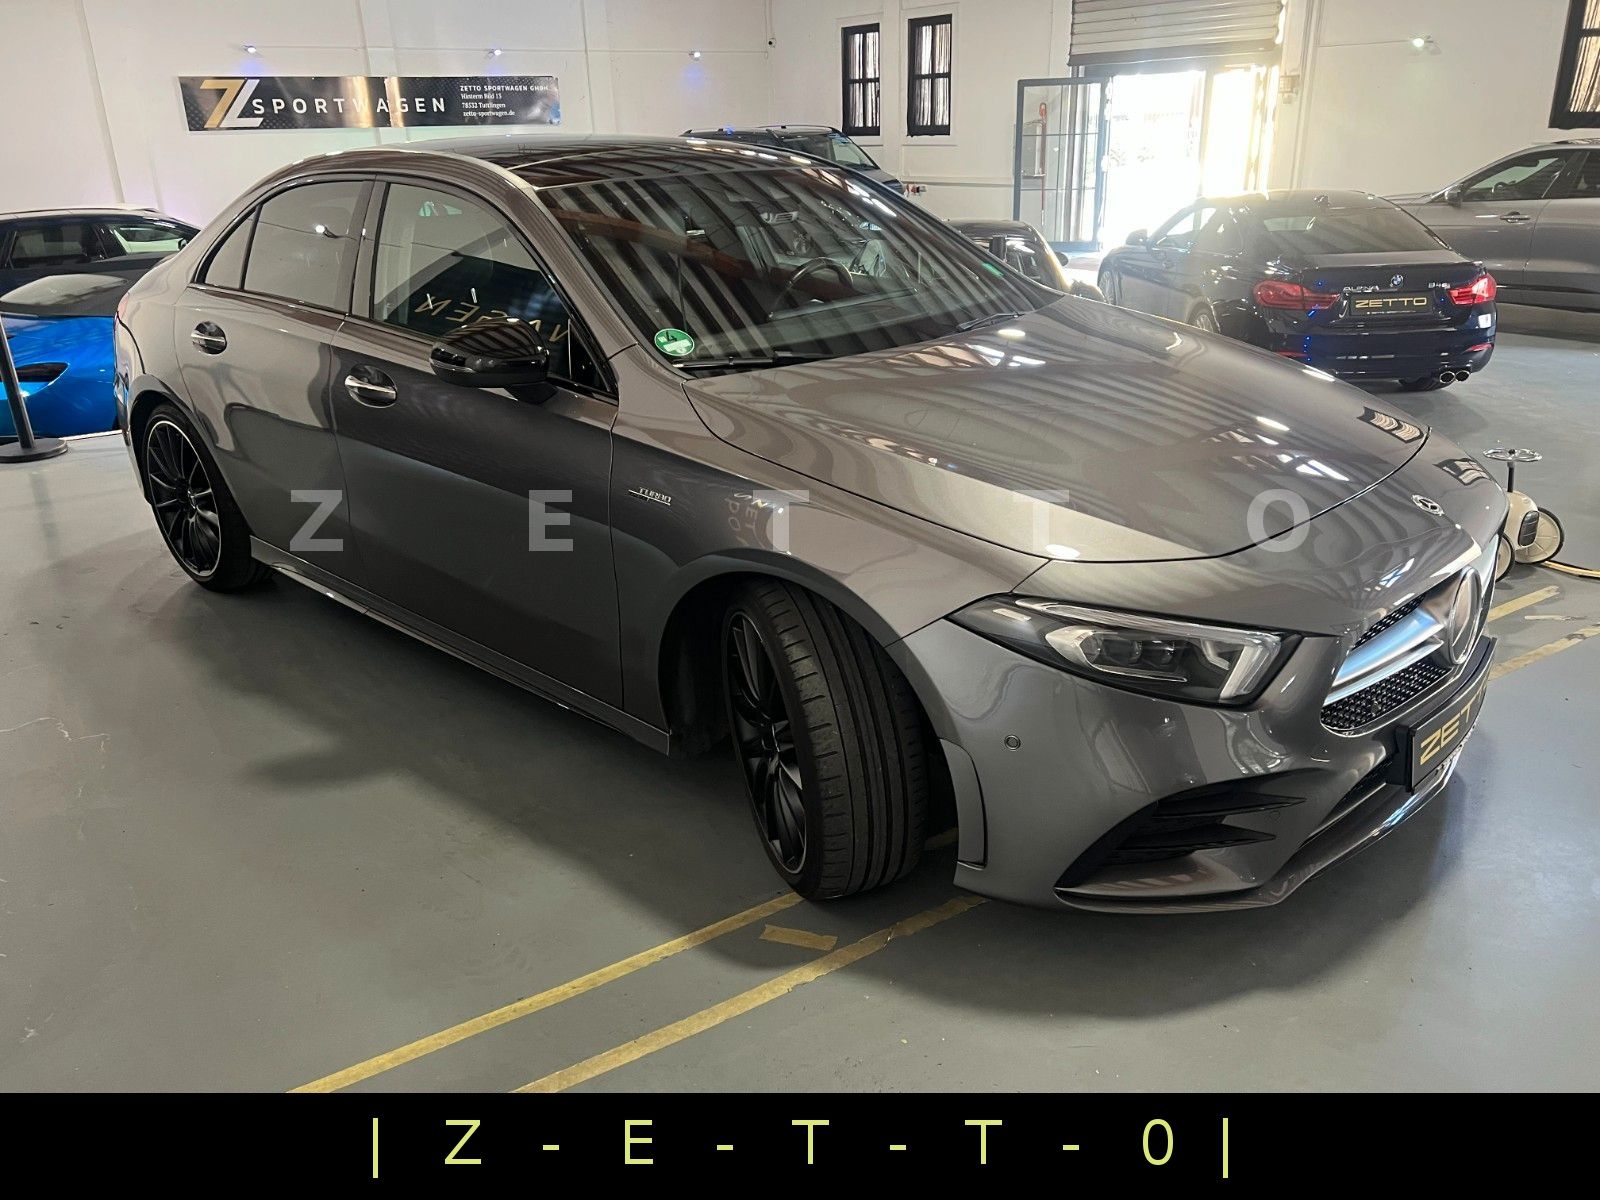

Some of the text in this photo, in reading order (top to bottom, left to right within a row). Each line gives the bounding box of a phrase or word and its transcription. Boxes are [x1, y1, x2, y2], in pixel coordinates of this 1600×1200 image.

[252, 97, 446, 113] SPORTWAGEN
[1355, 297, 1427, 308] ZETTO
[639, 487, 672, 504] TURBO
